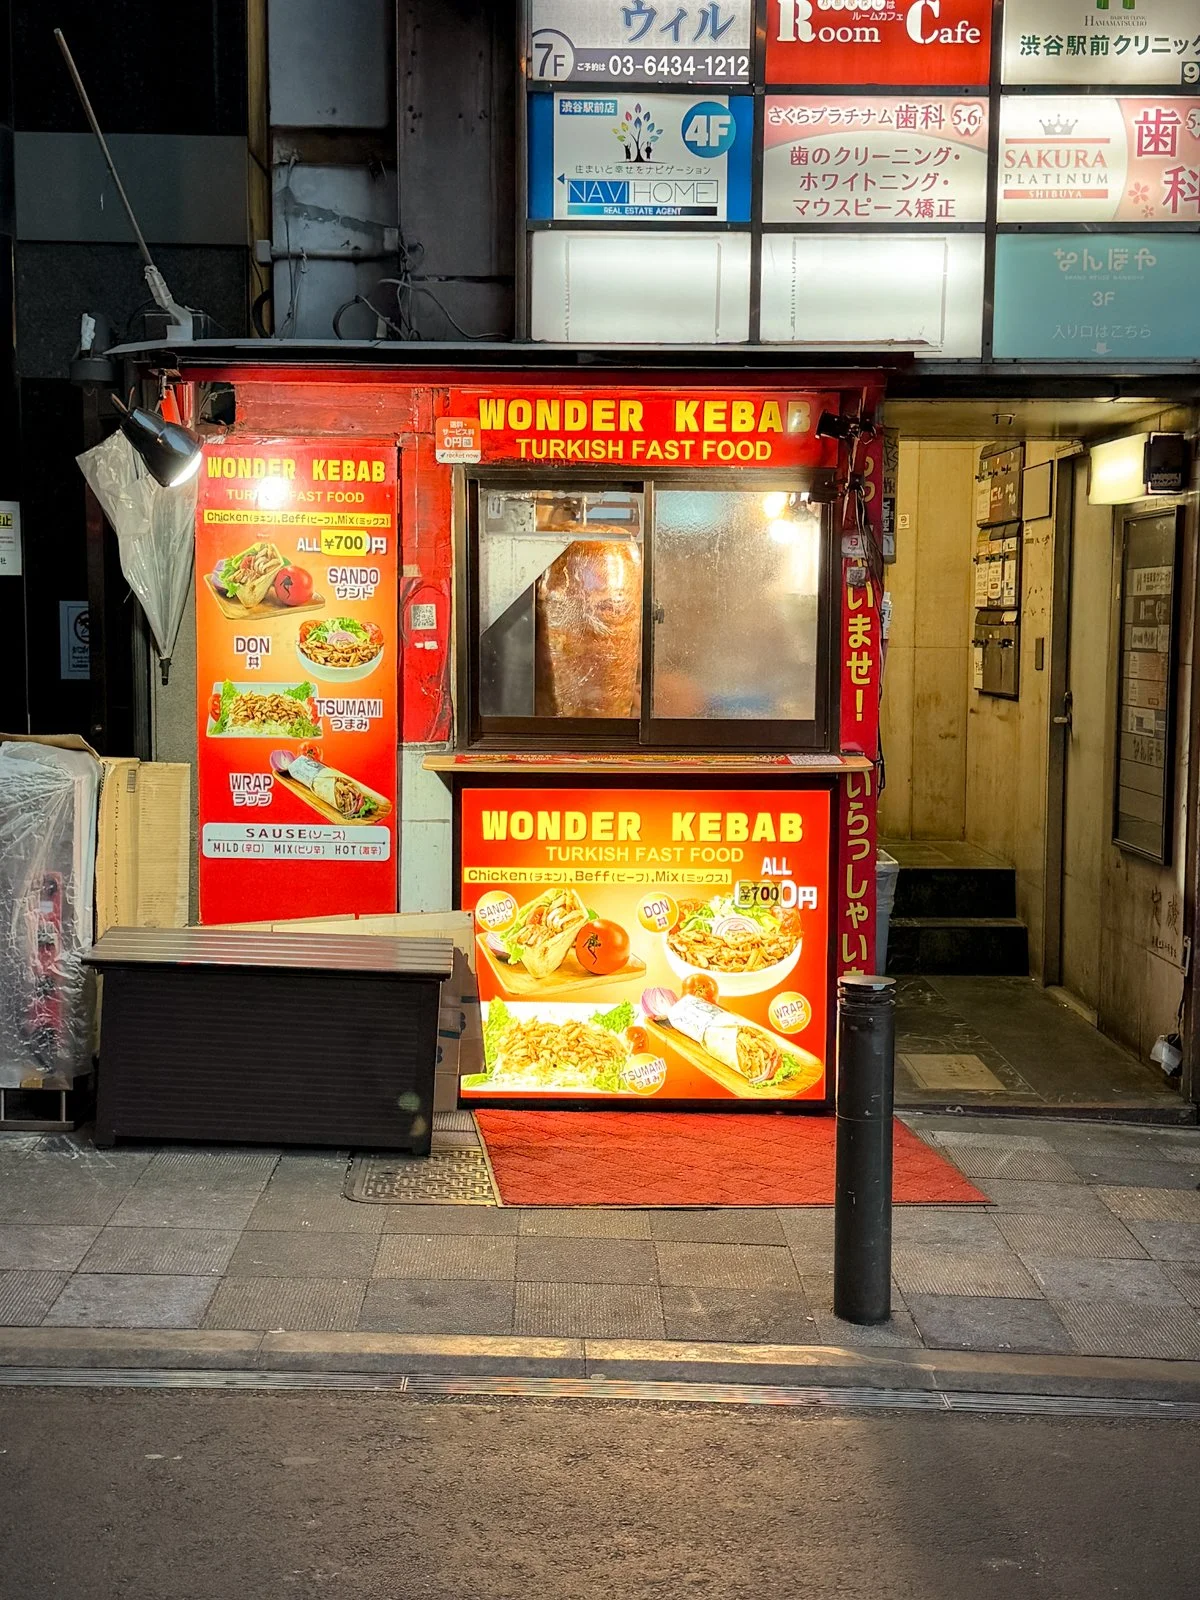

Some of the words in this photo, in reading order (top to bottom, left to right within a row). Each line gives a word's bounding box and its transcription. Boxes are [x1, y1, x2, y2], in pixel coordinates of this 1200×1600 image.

[620, 0, 736, 43] ウィル
[776, 0, 881, 43] Room
[906, 0, 981, 44] Cafe
[852, 12, 904, 21] ルームカフェ
[534, 43, 566, 78] 7F
[577, 62, 606, 72] ご予約は
[608, 55, 749, 77] 03-6434-1212
[561, 101, 615, 114] 渋谷駅前店
[684, 114, 731, 148] 4F
[1004, 149, 1108, 169] SAKURA
[575, 165, 712, 175] 住まいと幸せをナビゲーション
[1004, 173, 1108, 185] PLATINUM
[1028, 189, 1083, 199] SHIBUYA
[603, 207, 622, 215] REAL
[625, 207, 653, 215] ESTATE
[656, 207, 682, 216] AGENT
[793, 198, 957, 219] マウスピース矯正
[1053, 247, 1157, 272] なんぼや
[1092, 291, 1115, 306] 3F
[1052, 324, 1152, 339] 入り口はこちら
[479, 399, 644, 433] WONDER
[675, 400, 811, 434] KEBAB
[516, 438, 624, 460] TURKISH
[632, 440, 695, 461] FAST
[702, 440, 772, 461] FOOD
[207, 456, 296, 480] WONDER
[312, 459, 386, 483] KEBAB
[288, 491, 323, 502] FAST
[326, 491, 365, 503] FOOD
[297, 537, 320, 552] ALL
[324, 536, 363, 550] ¥700
[329, 568, 379, 584] SANDO
[336, 586, 374, 599] サンド
[235, 637, 270, 653] DON
[316, 700, 382, 718] TSUMAMI
[330, 719, 368, 730] つまみ
[230, 774, 272, 790] WRAP
[234, 793, 271, 805] ラップ
[481, 810, 642, 841] WONDER
[671, 811, 804, 843] KEBAB
[546, 846, 629, 862] TURKISH
[636, 847, 682, 862] FAST
[690, 847, 744, 863] FOOD
[761, 857, 792, 875] ALL
[842, 770, 872, 975] いらっしゃい
[479, 898, 513, 919] SANDO
[643, 899, 670, 919] DON
[774, 1000, 804, 1019] WRAP
[622, 1058, 666, 1082] TSUMAMI
